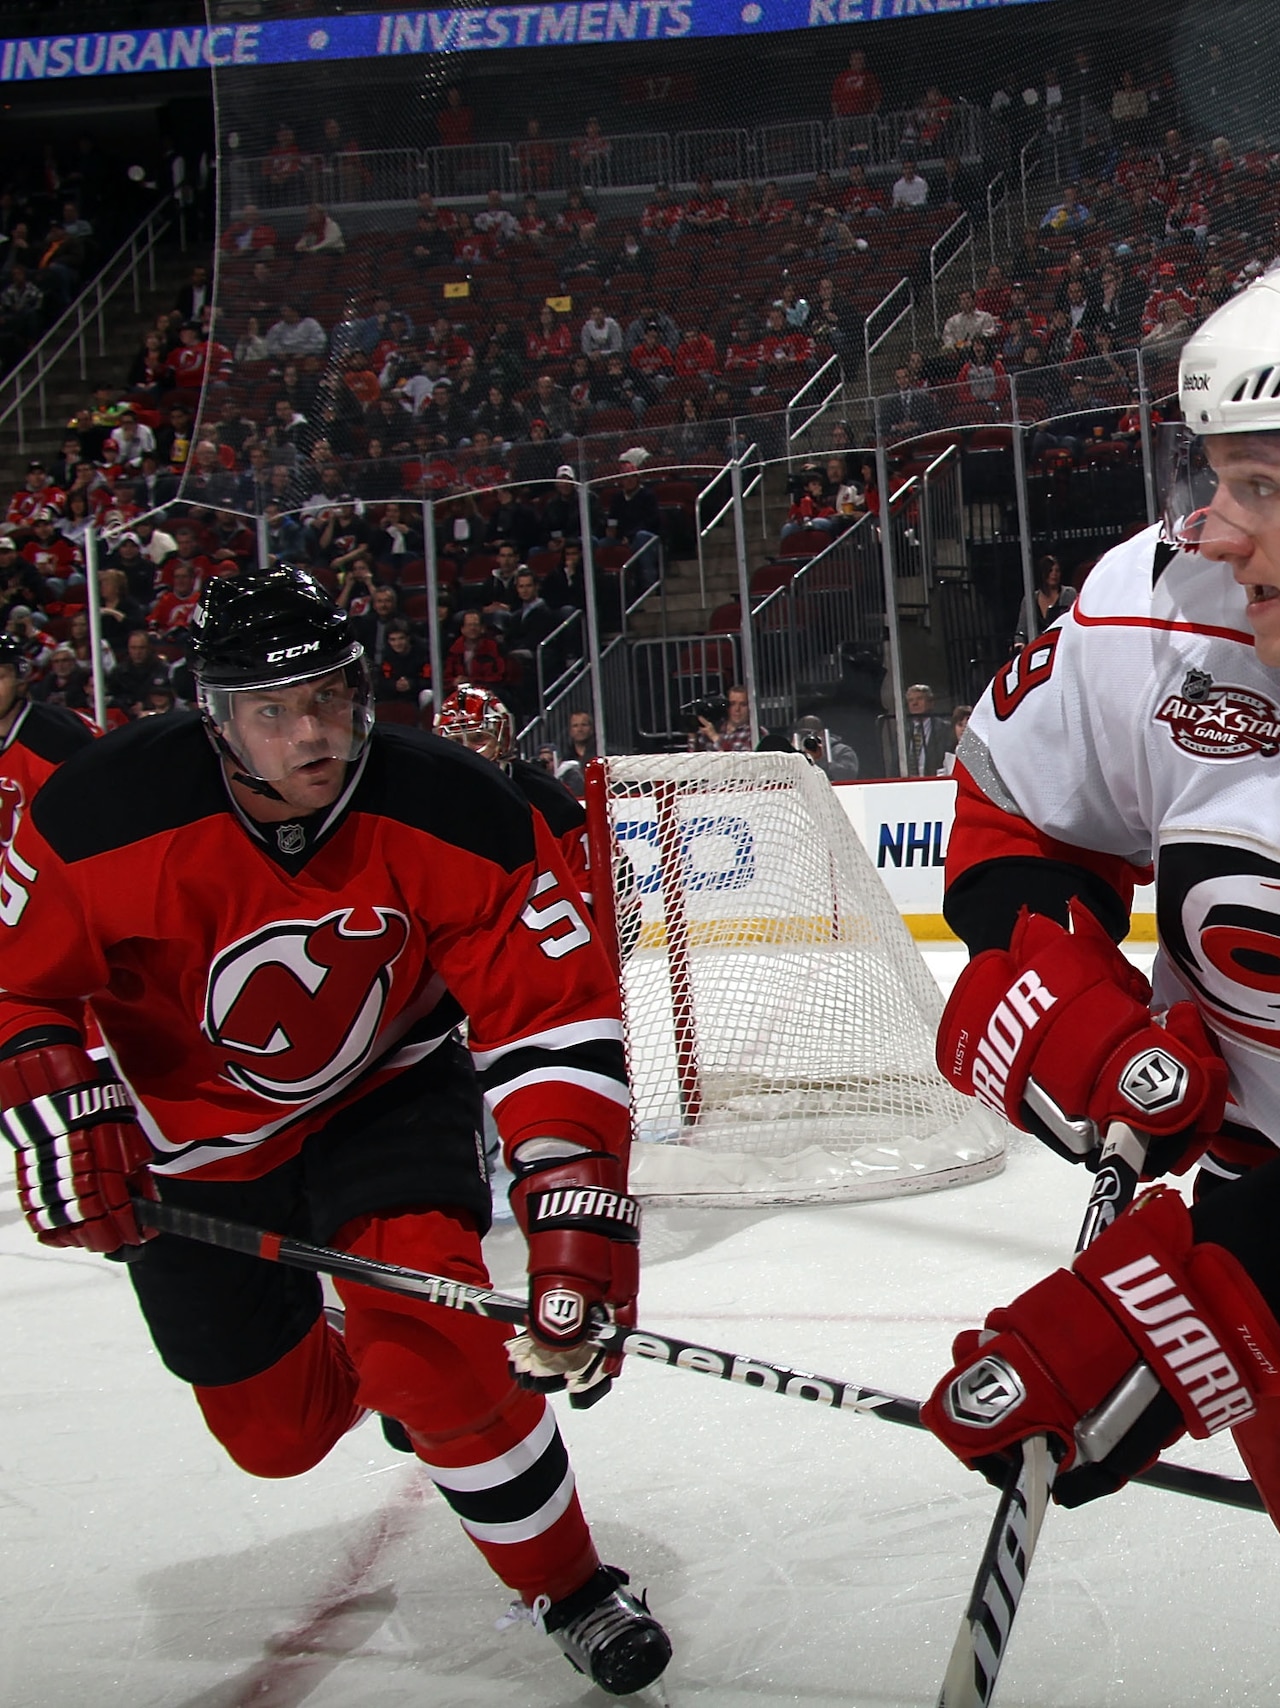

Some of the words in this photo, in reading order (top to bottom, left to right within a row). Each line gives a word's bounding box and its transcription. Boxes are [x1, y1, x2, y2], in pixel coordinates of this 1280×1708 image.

[0, 25, 262, 81] INSURANCE
[378, 0, 692, 54] INVESTMENTS
[266, 640, 320, 663] CCM
[1164, 698, 1197, 720] ALL
[1193, 727, 1239, 744] GAME
[520, 869, 591, 959] 5
[953, 1029, 969, 1076] TLUSTY
[1237, 1324, 1279, 1375] TLUSTY
